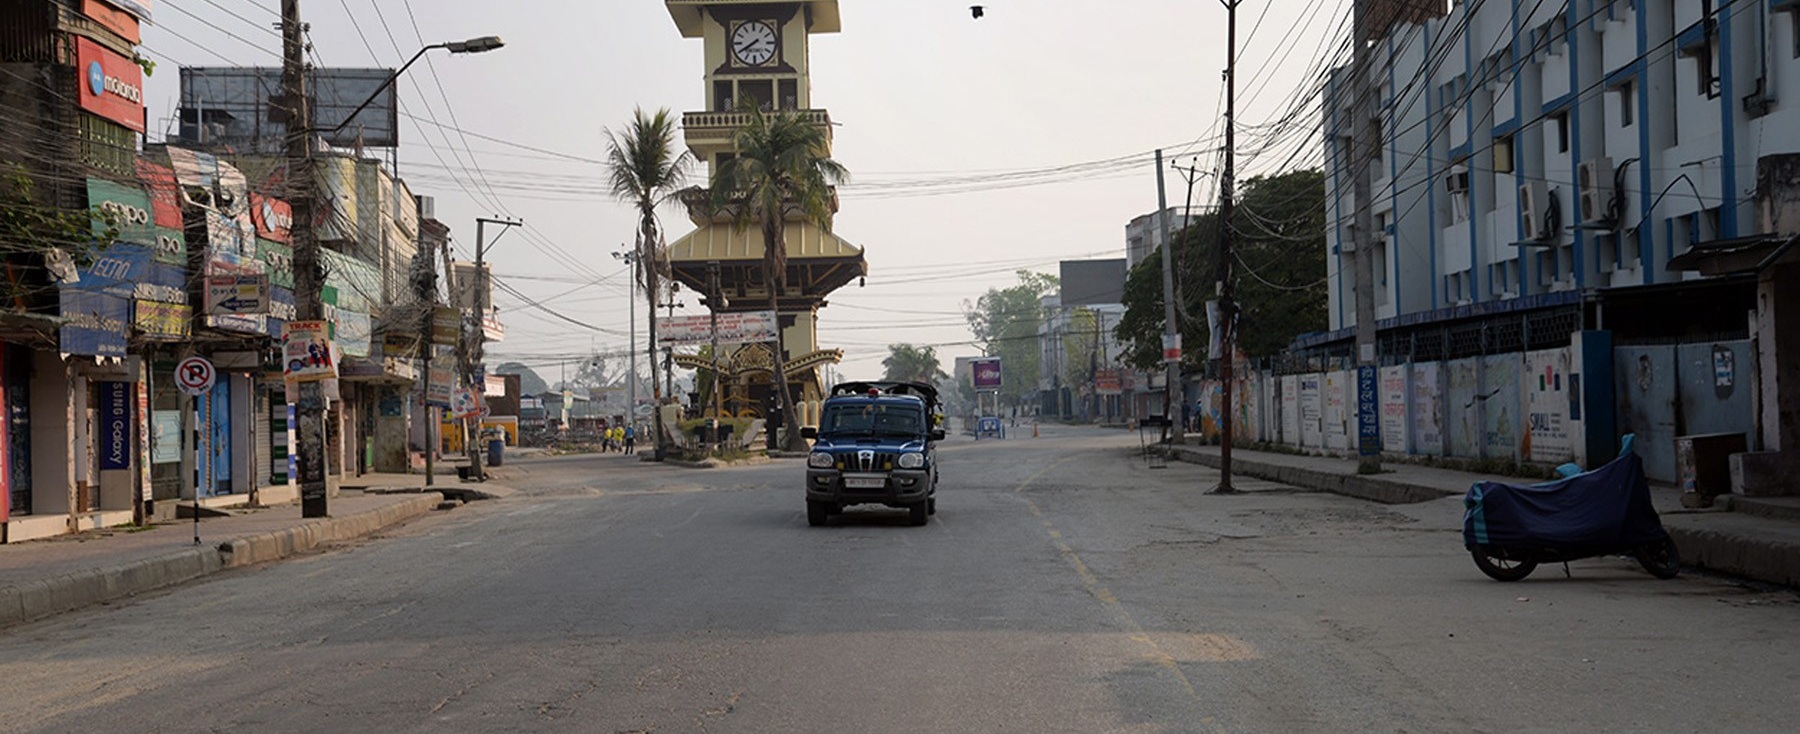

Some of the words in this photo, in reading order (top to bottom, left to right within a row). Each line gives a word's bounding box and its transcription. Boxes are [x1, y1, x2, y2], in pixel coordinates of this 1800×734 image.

[104, 75, 141, 104] motorola
[289, 322, 321, 331] TRACK
[1530, 412, 1550, 431] SMALL
[110, 419, 125, 465] Galaxy
